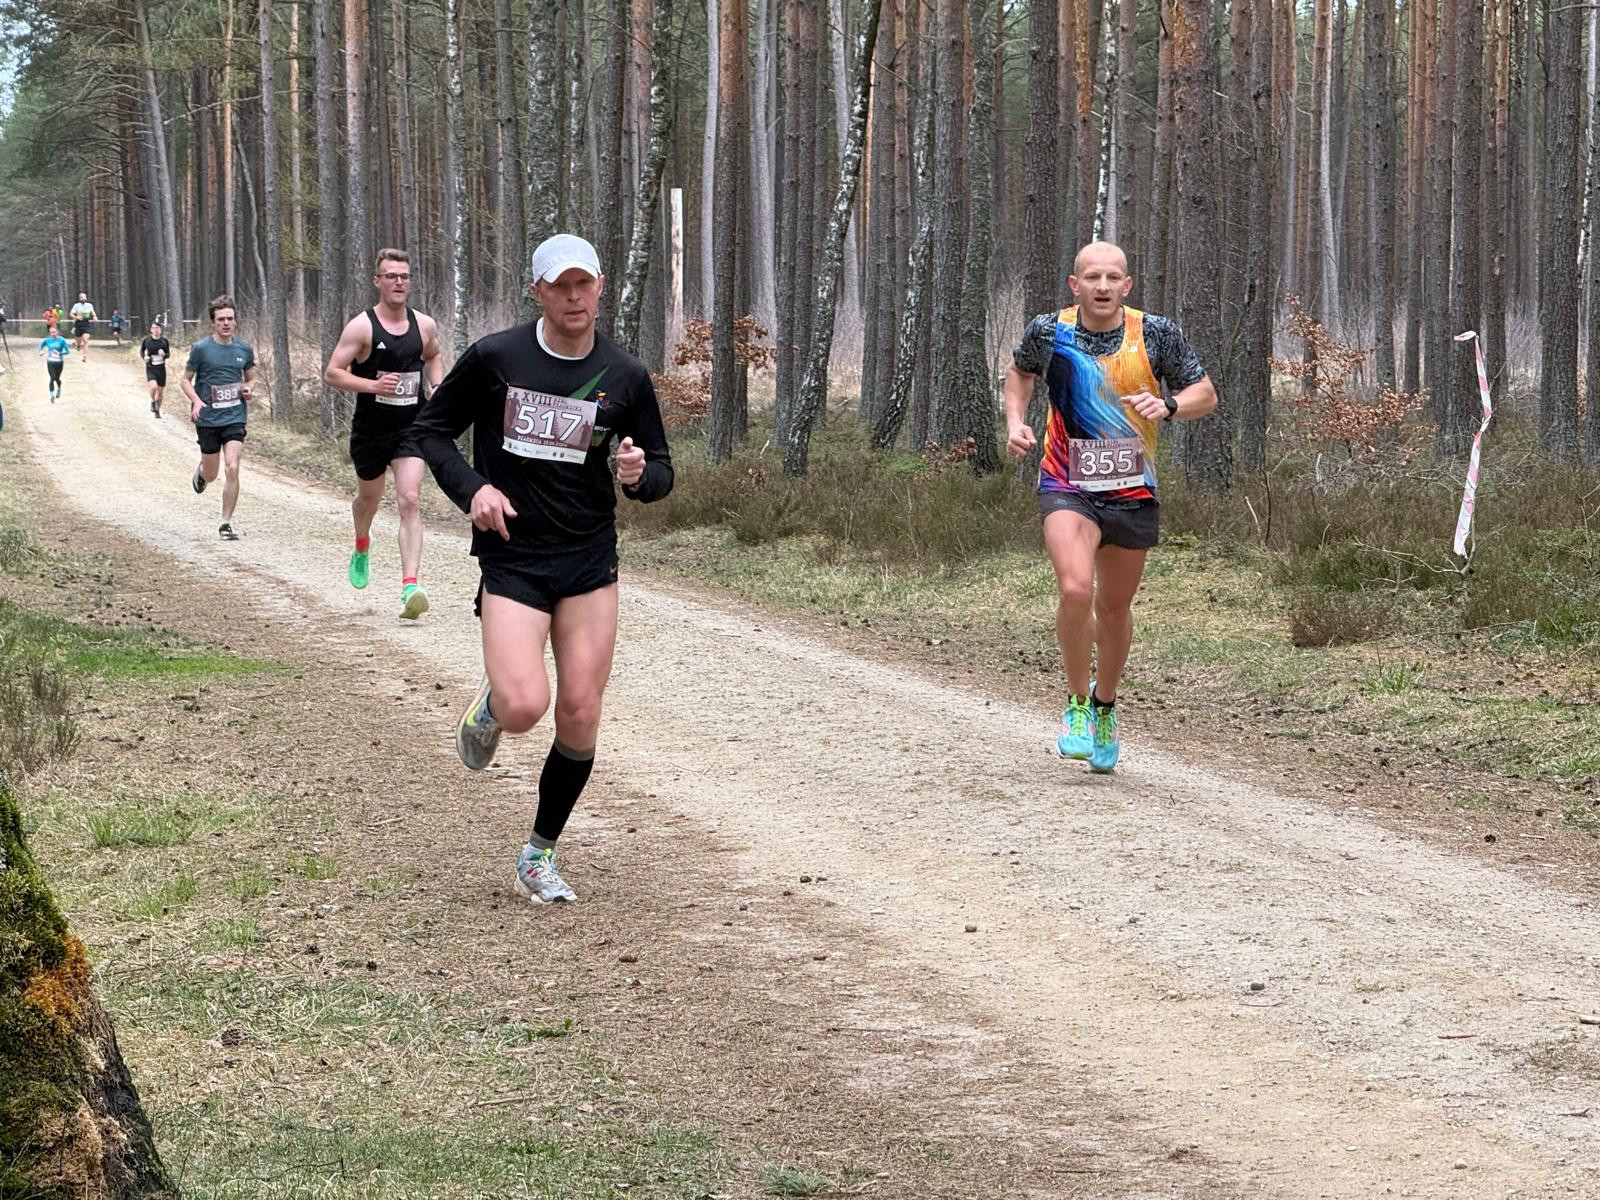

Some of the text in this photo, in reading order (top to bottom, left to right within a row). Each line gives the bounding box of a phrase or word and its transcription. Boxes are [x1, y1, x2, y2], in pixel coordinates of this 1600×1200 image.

[393, 380, 414, 395] 61
[522, 392, 552, 406] XVIII
[514, 403, 583, 442] 517
[1081, 440, 1106, 449] XVIII
[1080, 449, 1133, 476] 355
